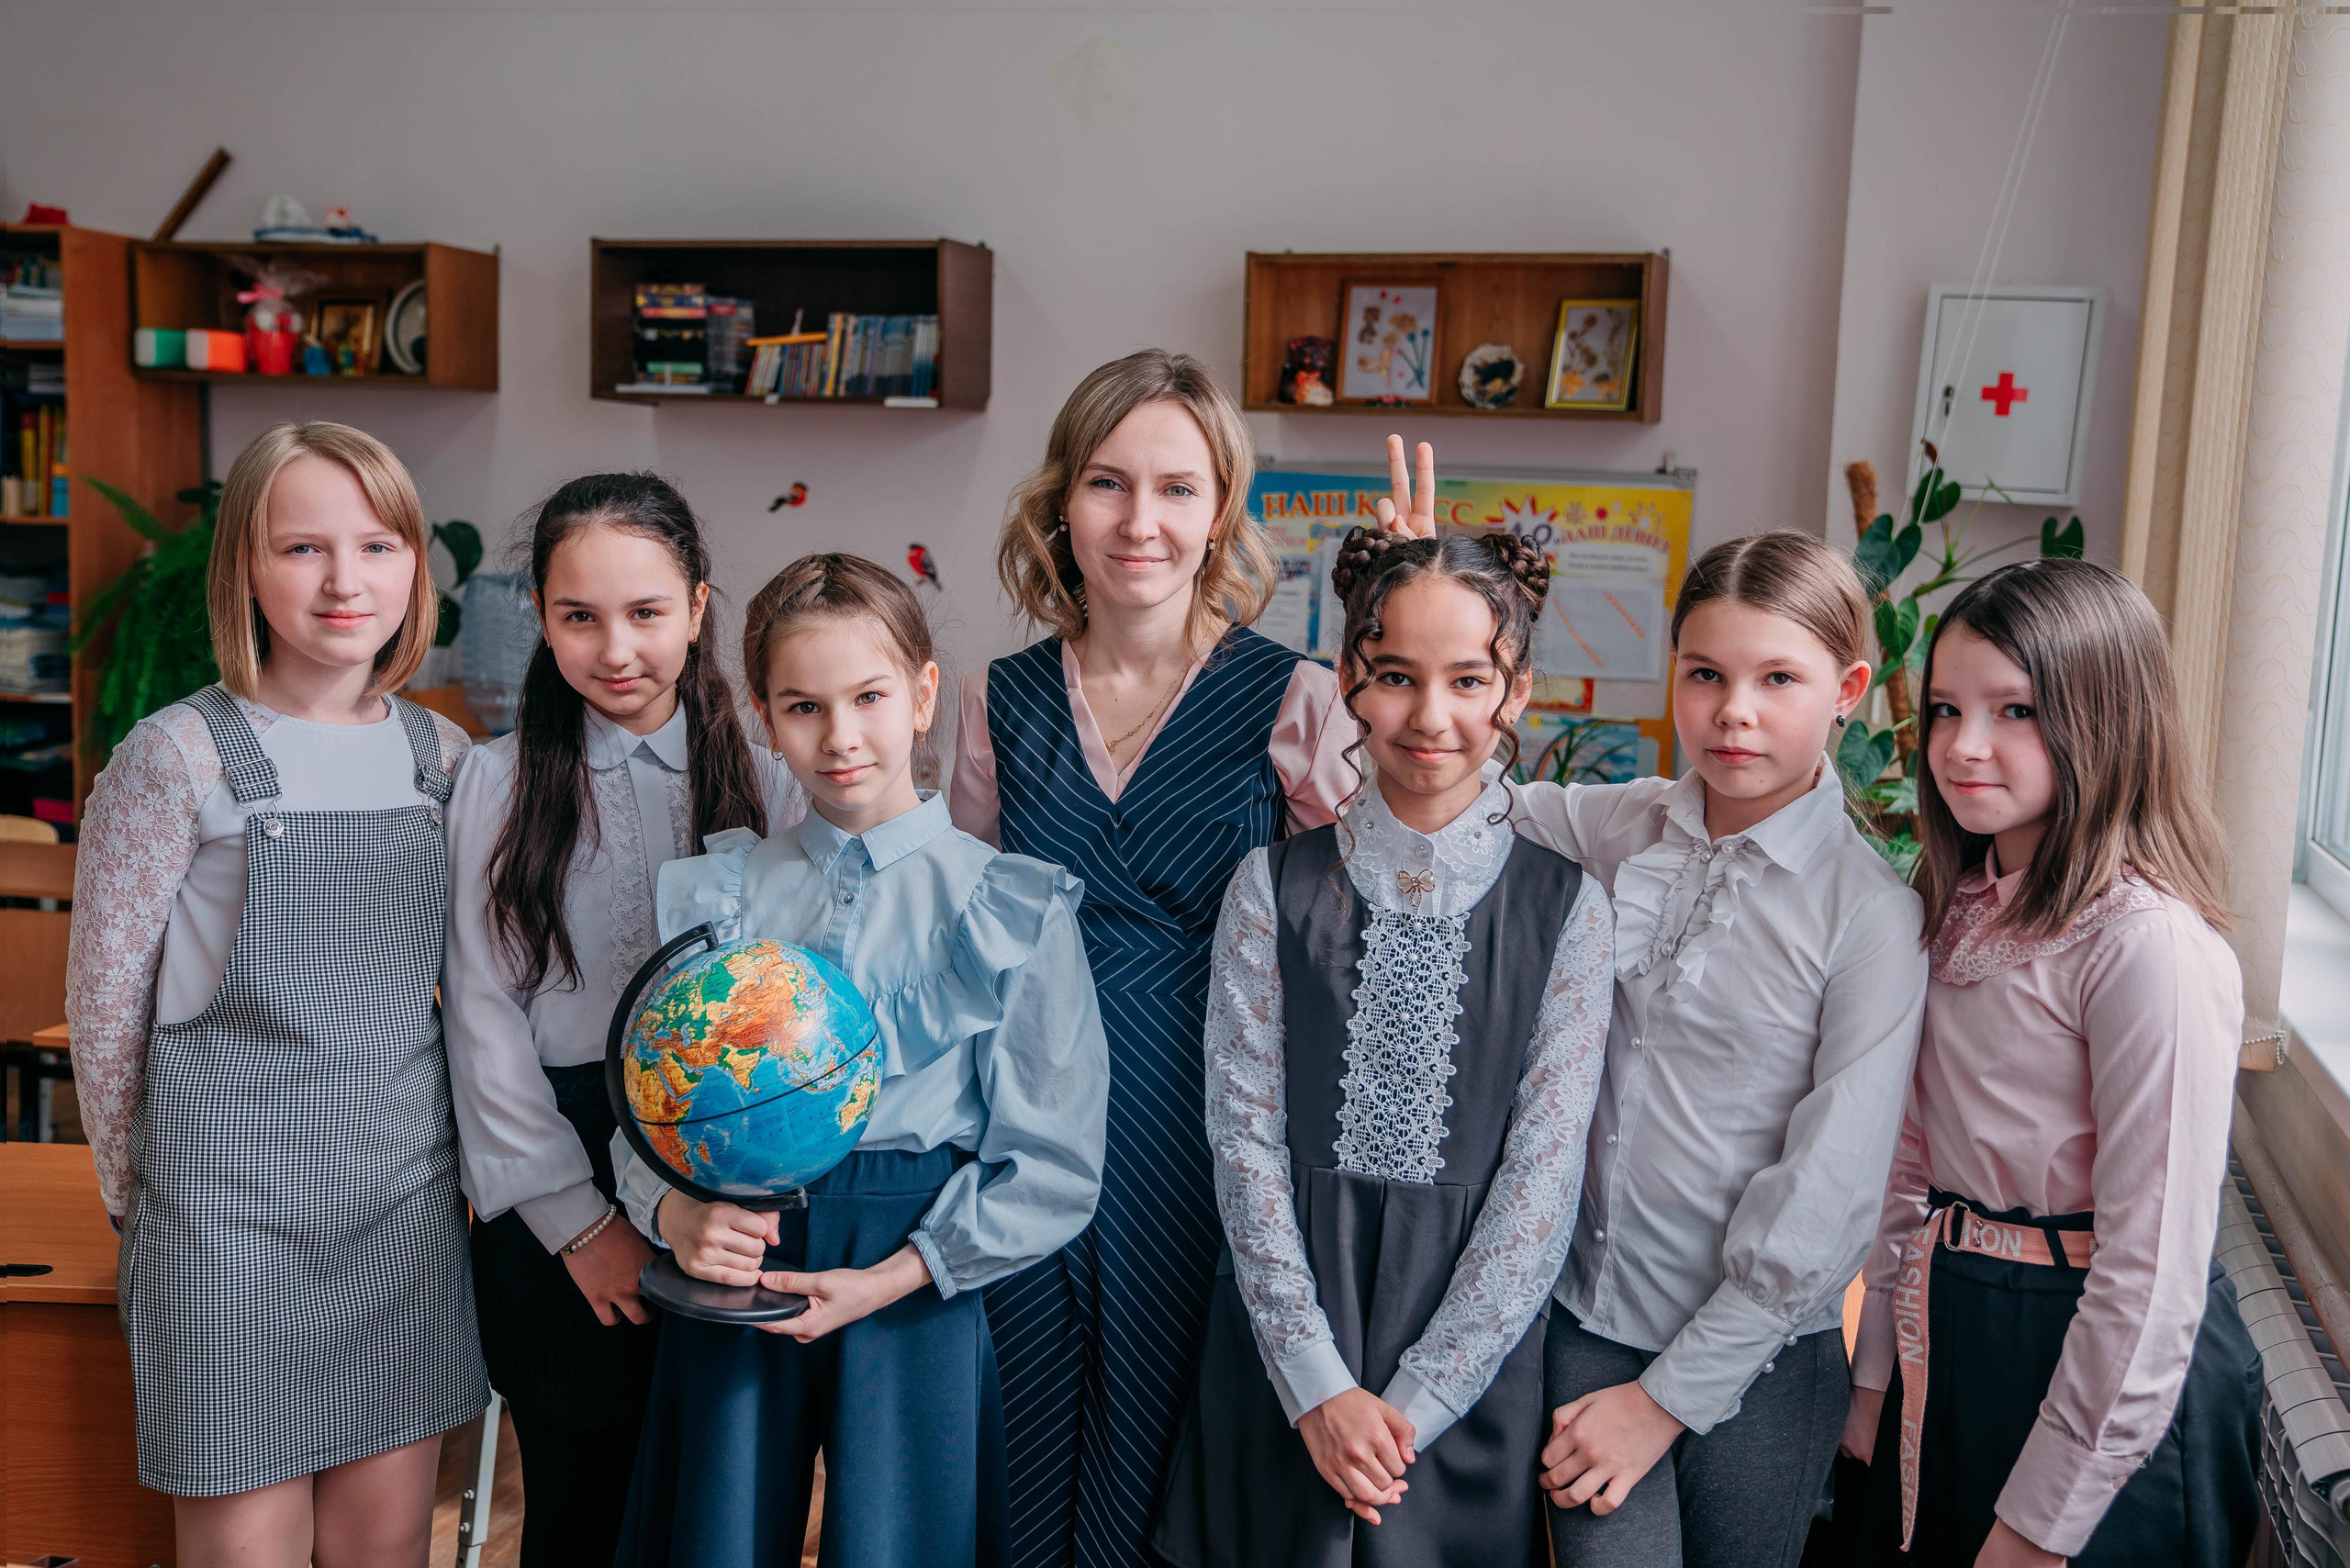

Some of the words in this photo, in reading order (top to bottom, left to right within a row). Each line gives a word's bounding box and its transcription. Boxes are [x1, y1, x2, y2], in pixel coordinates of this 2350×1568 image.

[1262, 491, 1348, 519] НАШ
[1355, 491, 1475, 526] КСС
[1896, 1226, 1931, 1365] FASHION
